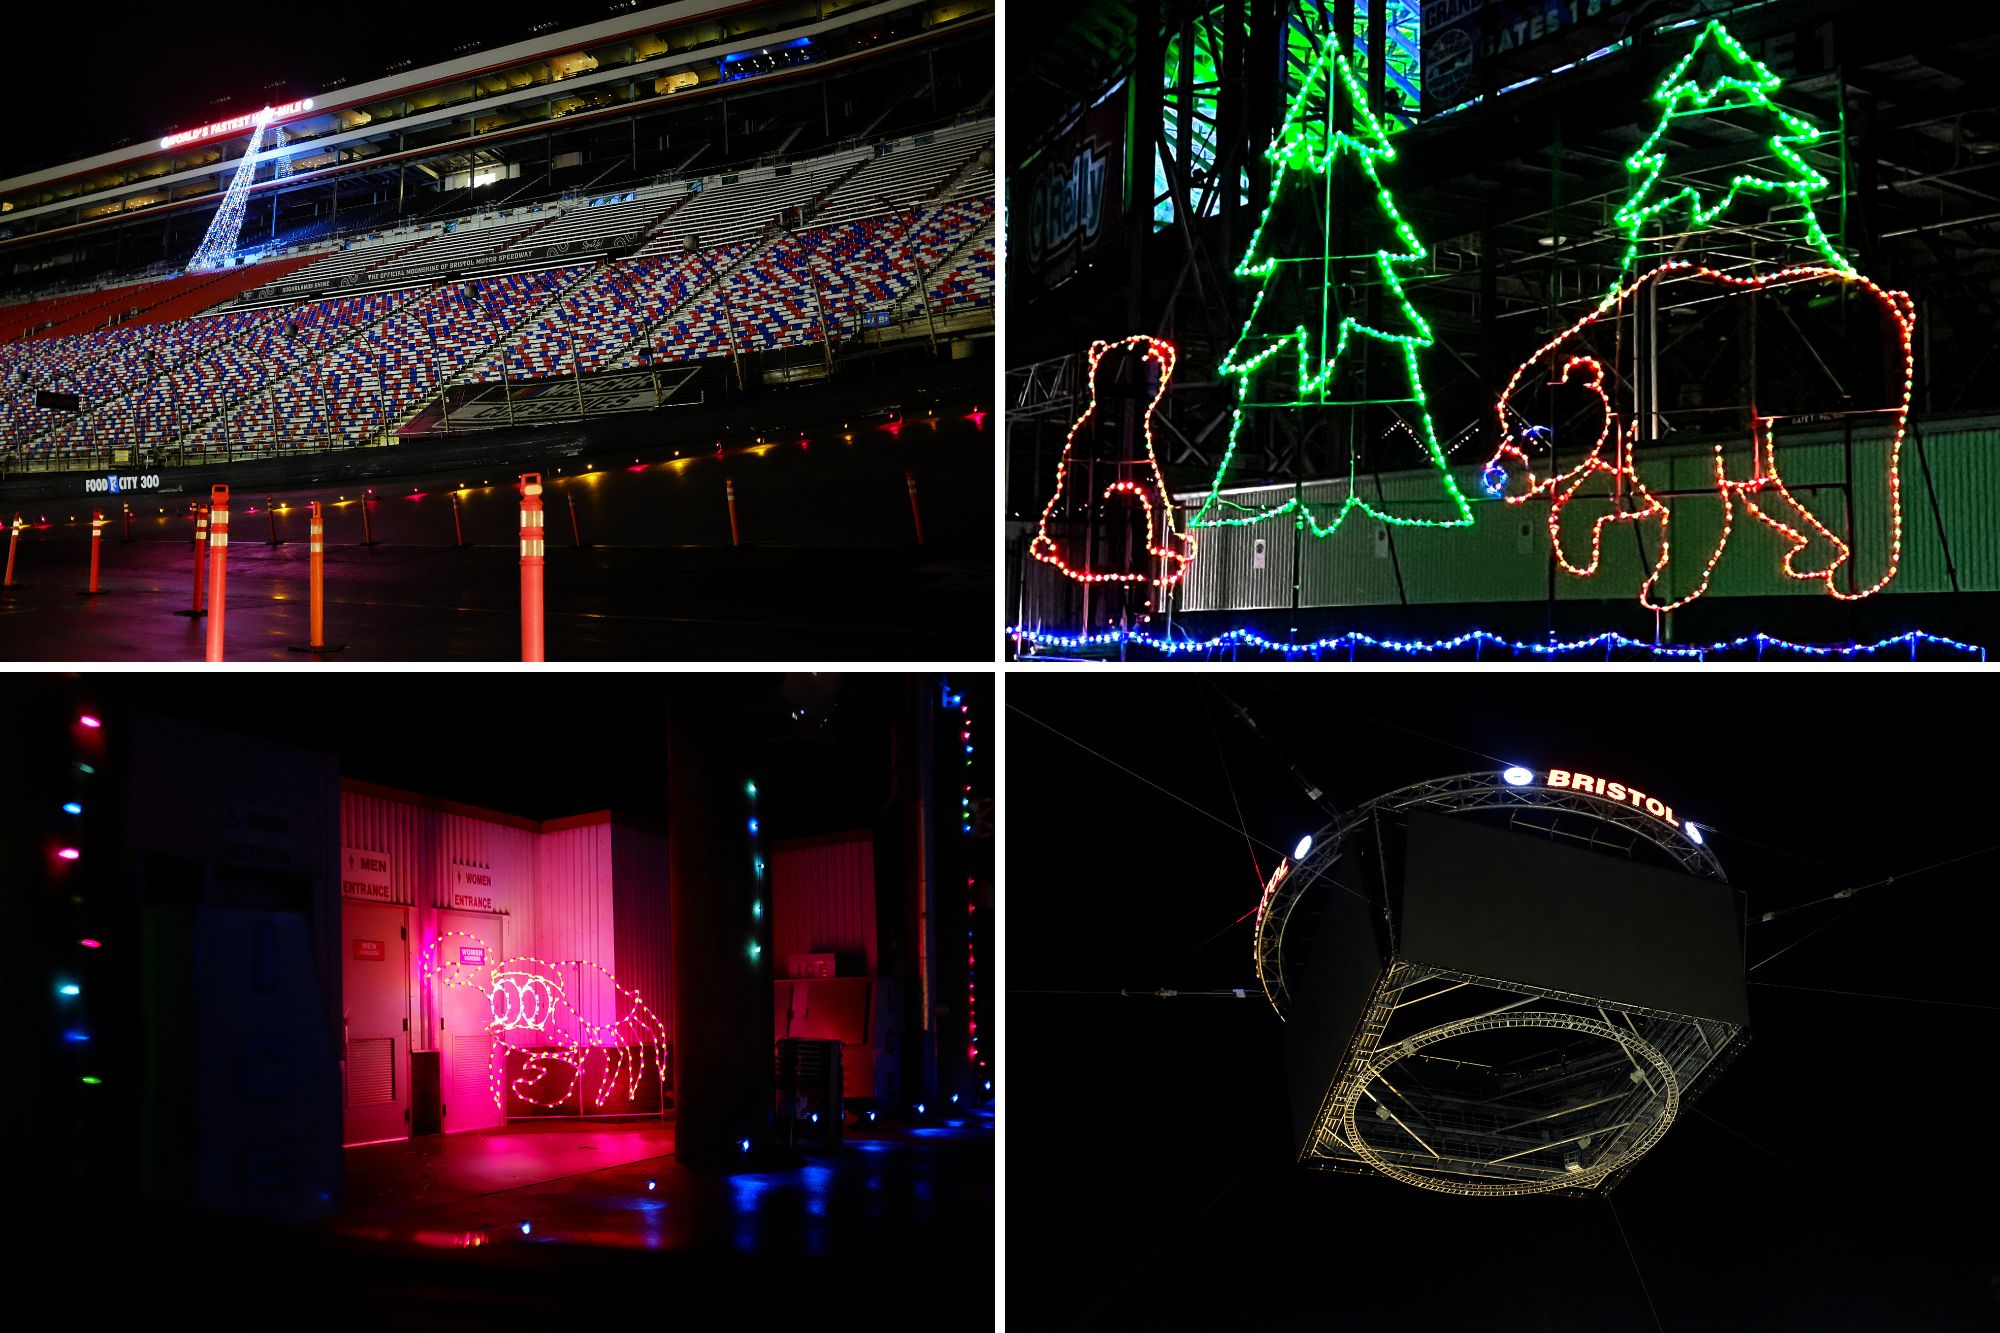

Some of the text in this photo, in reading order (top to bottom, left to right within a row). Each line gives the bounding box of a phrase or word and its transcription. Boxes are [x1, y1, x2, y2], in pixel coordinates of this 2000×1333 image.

[210, 115, 250, 135] FASTEST
[380, 270, 405, 280] OFFICIAL
[406, 265, 440, 278] MOONSHINE
[440, 263, 449, 271] OF
[449, 259, 475, 270] BRISTOL
[476, 256, 498, 267] MOTOR
[498, 250, 534, 265] SPEEDWAY
[86, 479, 108, 492] FOOD
[119, 476, 138, 490] CITY
[140, 474, 160, 489] 300
[1547, 769, 1680, 827] BRISTOL
[360, 857, 387, 873] MEN
[466, 872, 492, 887] WOMEN
[343, 881, 389, 898] ENTRANCE
[455, 895, 492, 909] ENTRANCE
